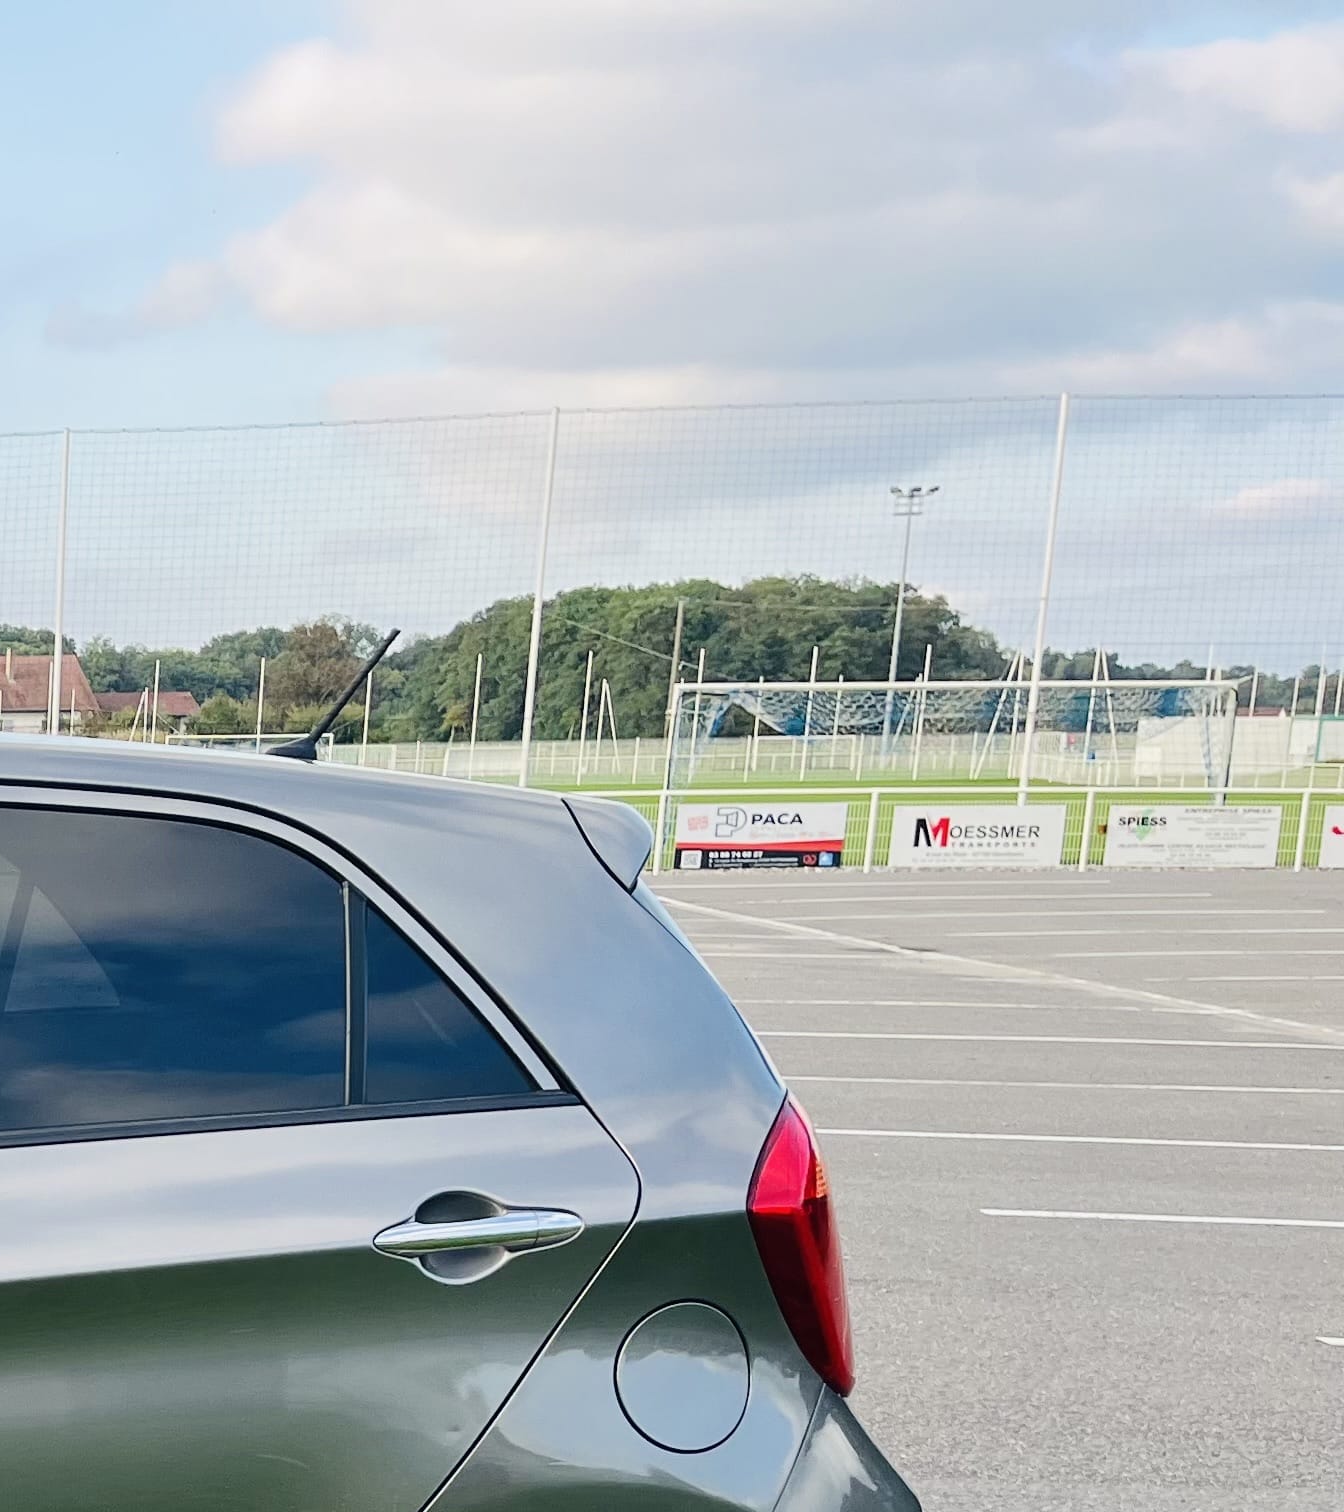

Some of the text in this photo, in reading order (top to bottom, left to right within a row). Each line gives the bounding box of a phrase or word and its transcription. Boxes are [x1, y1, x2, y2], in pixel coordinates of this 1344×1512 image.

[751, 813, 804, 825] PACA
[1118, 816, 1168, 827] SPIESS
[913, 815, 1041, 848] MOESSMER
